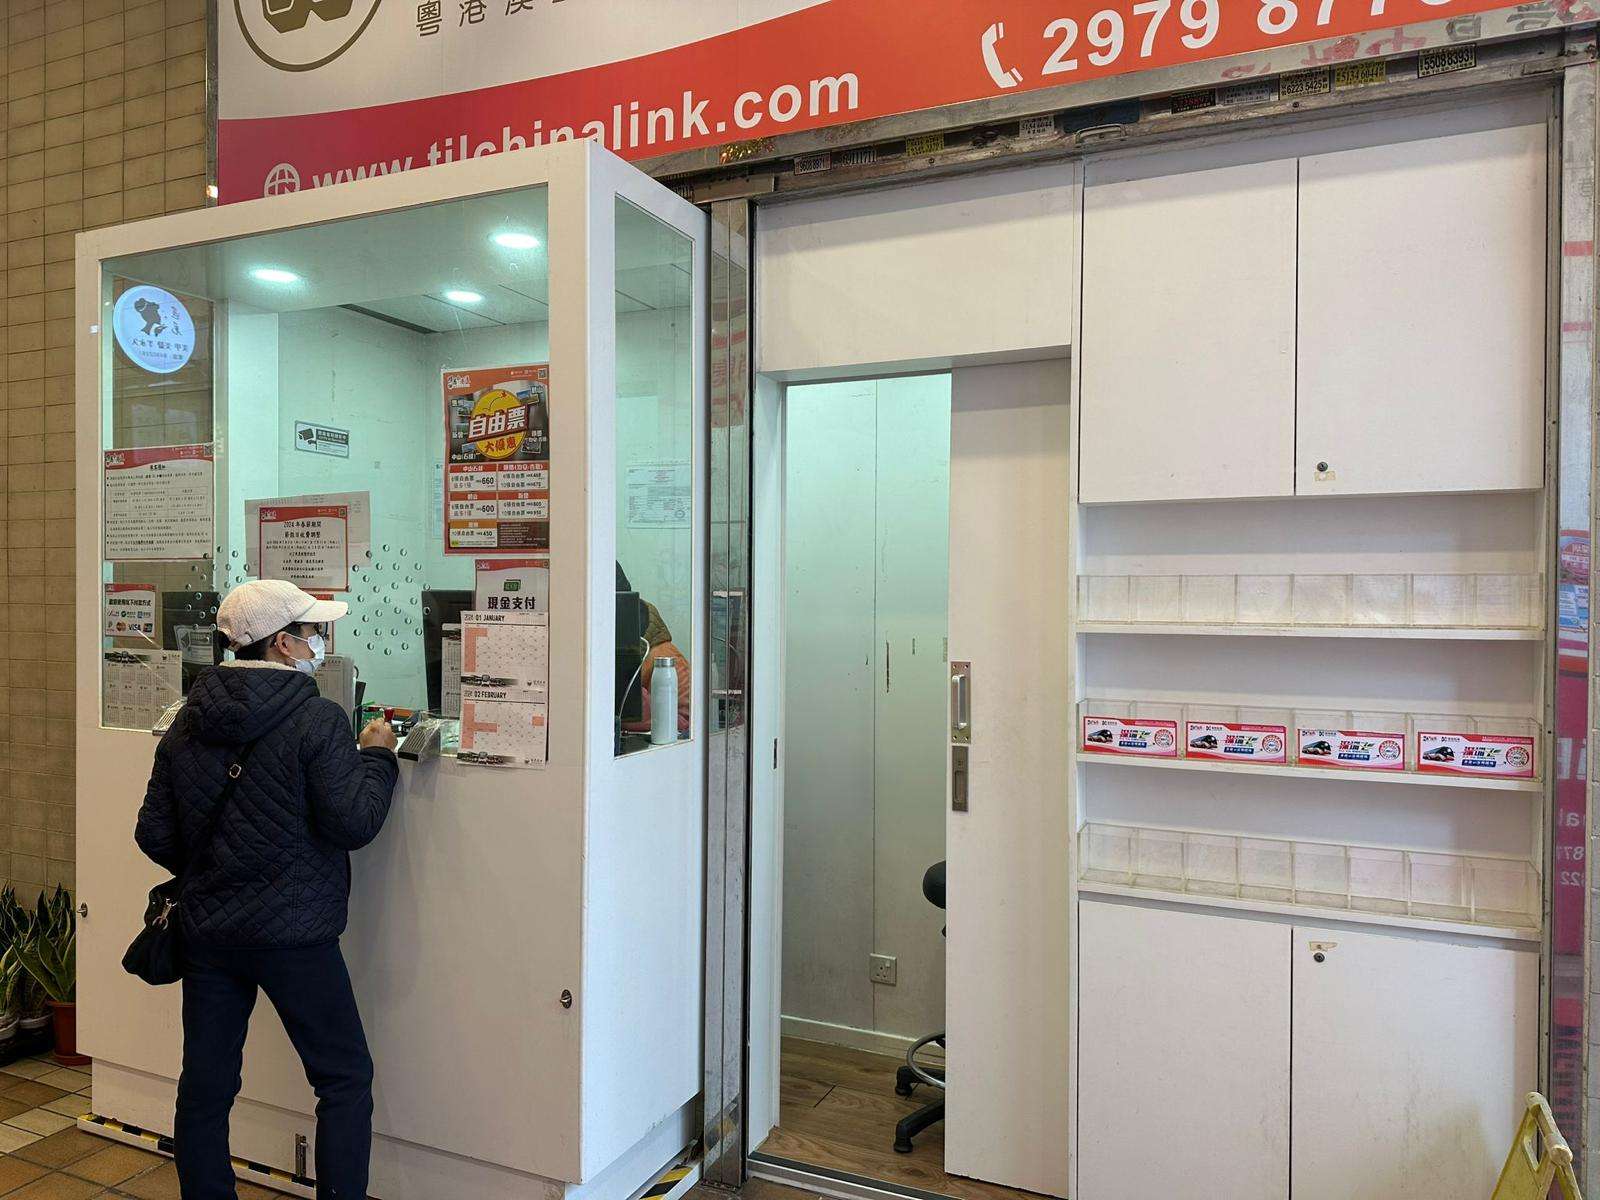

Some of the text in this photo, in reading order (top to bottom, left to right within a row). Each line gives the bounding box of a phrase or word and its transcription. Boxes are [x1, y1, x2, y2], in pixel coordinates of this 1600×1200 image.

[1041, 0, 1220, 76] 2979
[468, 405, 526, 439] 自由票
[487, 596, 537, 610] 現金支付
[483, 614, 505, 622] JANUARY
[481, 691, 507, 699] FEBRUARY
